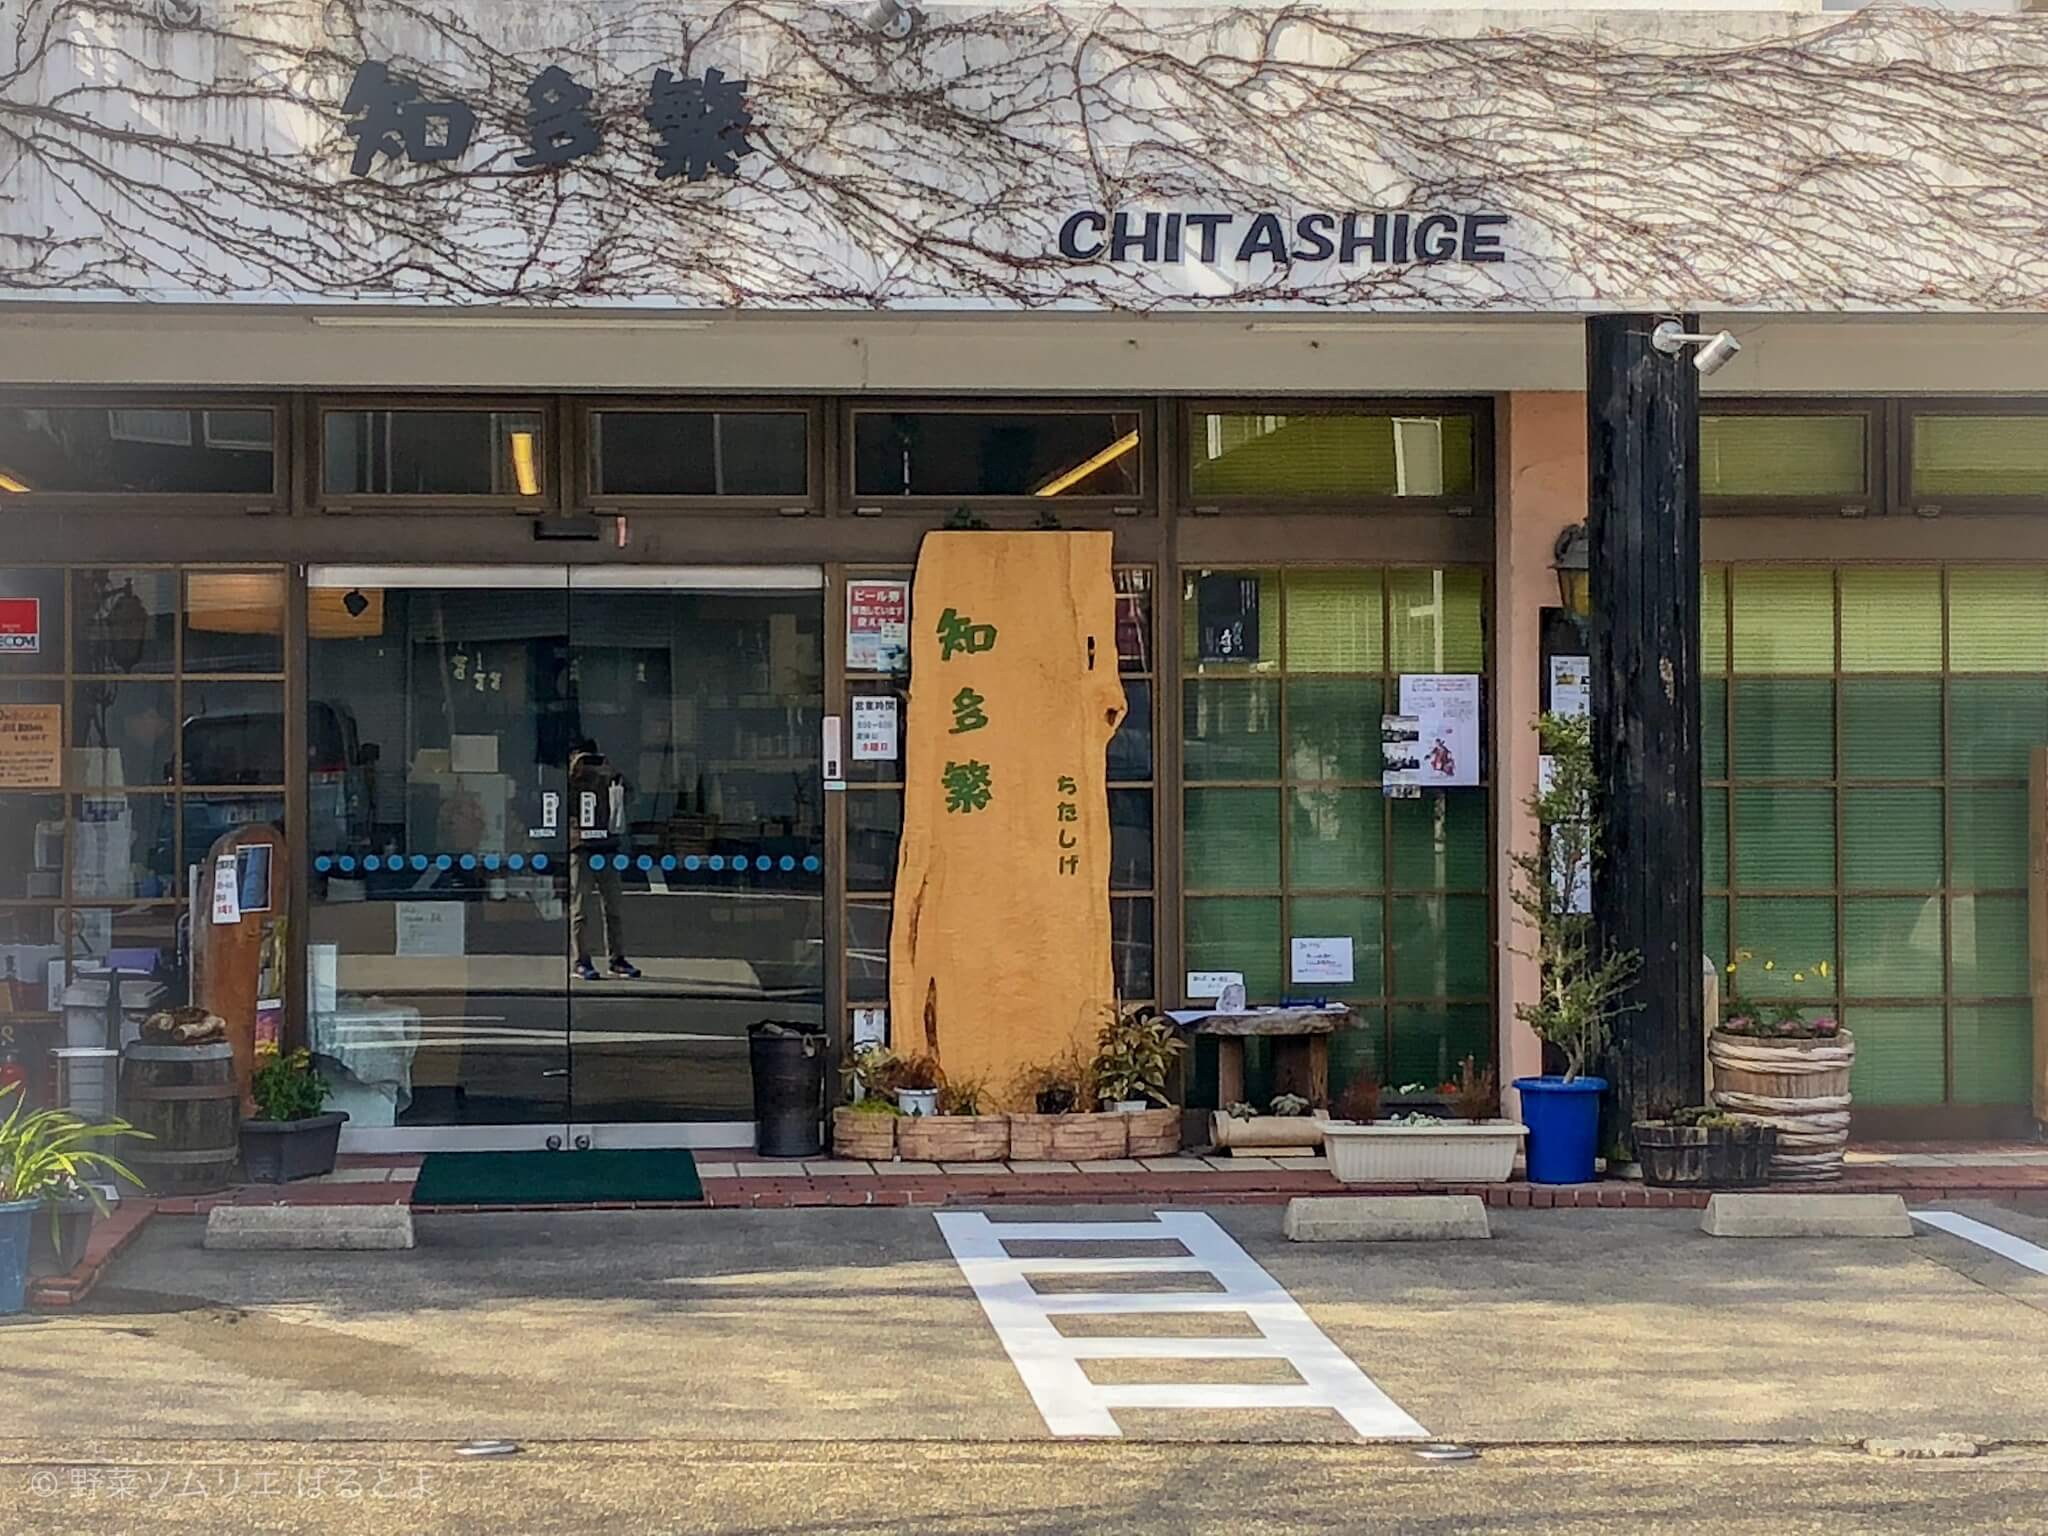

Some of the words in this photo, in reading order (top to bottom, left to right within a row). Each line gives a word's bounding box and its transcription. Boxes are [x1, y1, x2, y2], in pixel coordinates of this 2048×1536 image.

[341, 59, 755, 182] 知多繁
[1059, 210, 1509, 263] CHITASHIGE
[936, 608, 998, 813] 知多繁
[1057, 775, 1079, 875] ちたしげ
